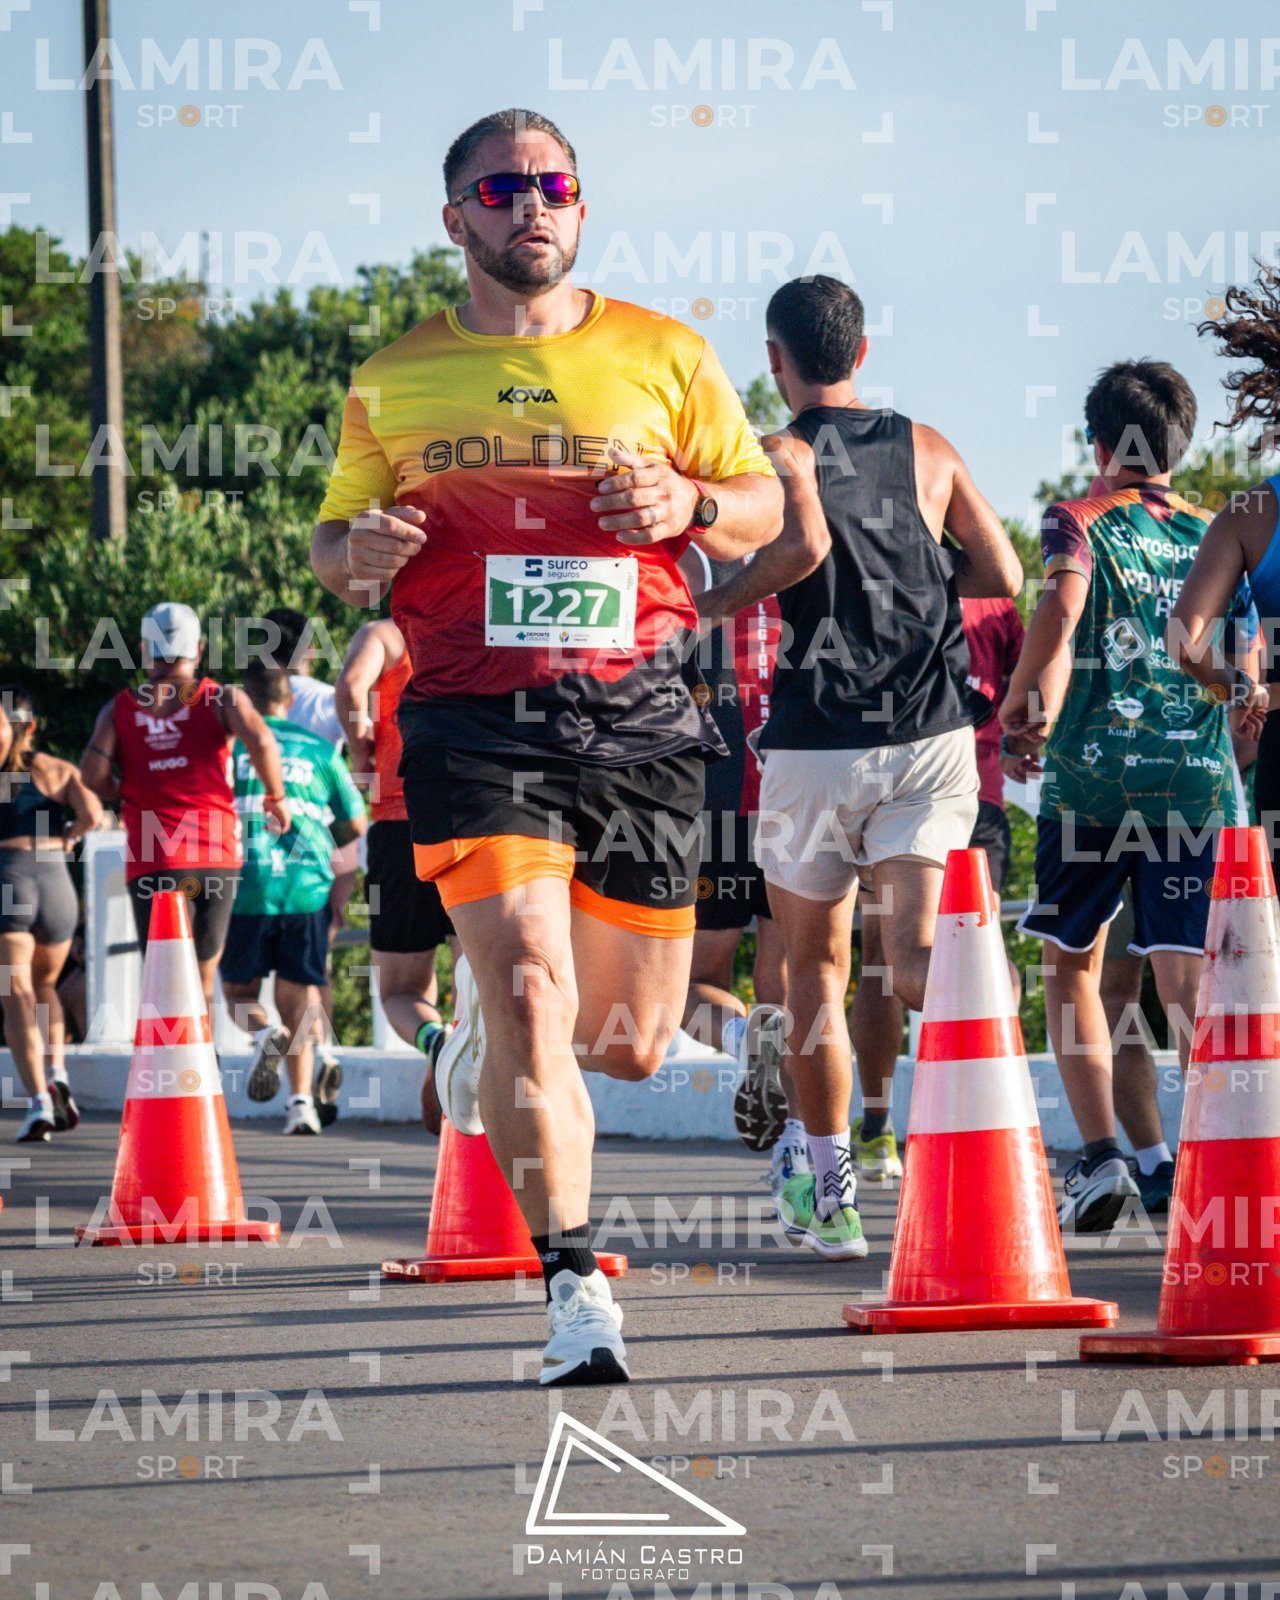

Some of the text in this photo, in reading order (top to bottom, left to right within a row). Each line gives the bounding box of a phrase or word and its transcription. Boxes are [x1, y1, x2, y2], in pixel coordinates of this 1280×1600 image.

[497, 386, 558, 404] KOVA
[547, 559, 588, 571] surco
[547, 571, 580, 580] seguros
[505, 586, 609, 625] 1227
[148, 756, 189, 772] HUGO
